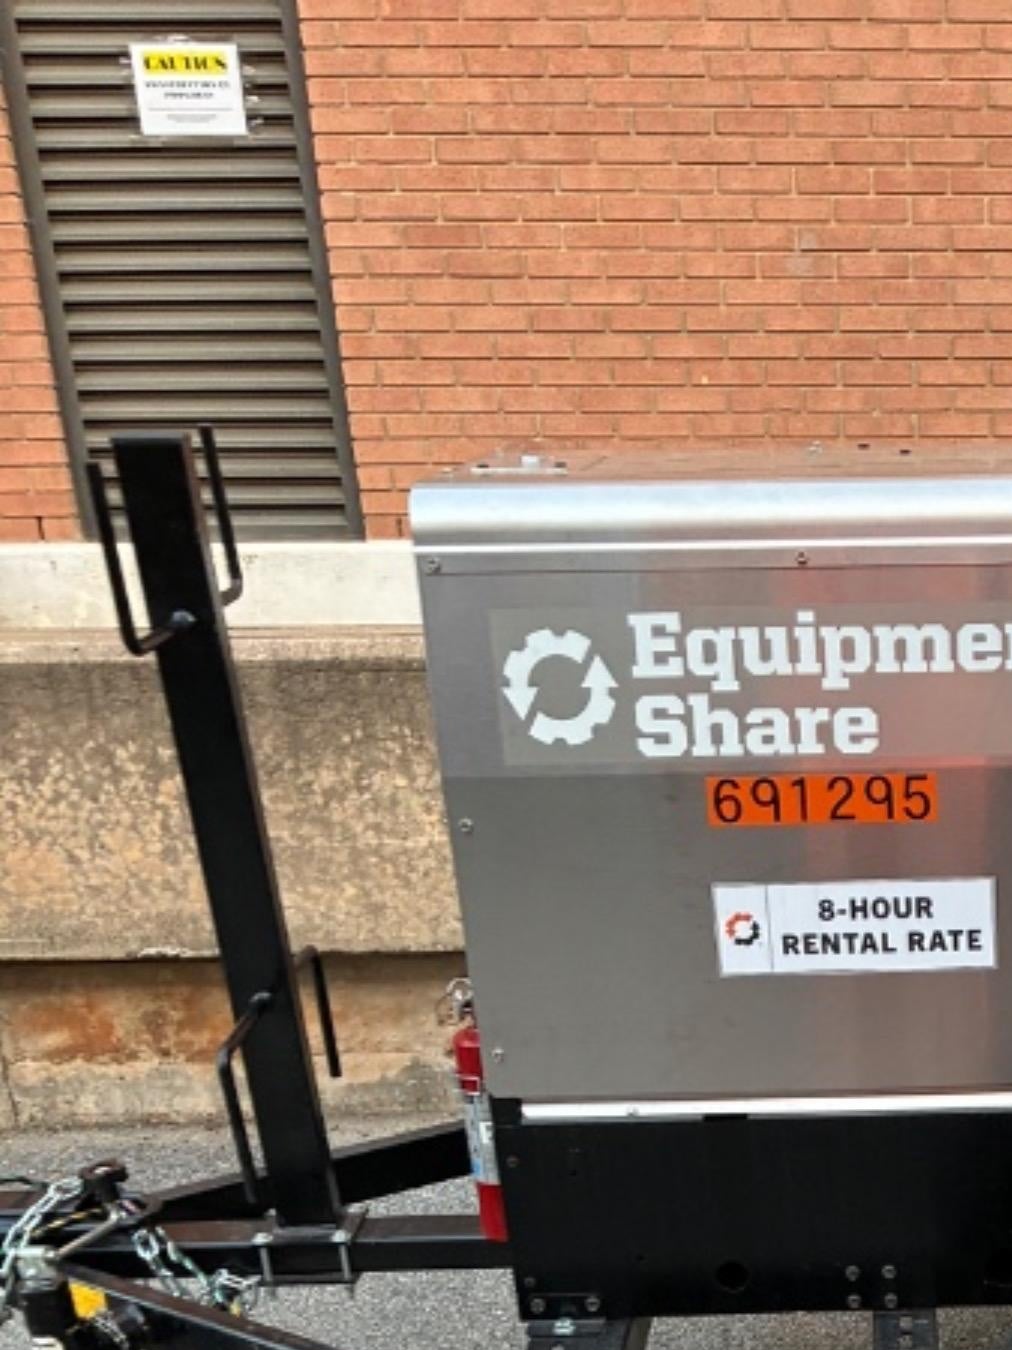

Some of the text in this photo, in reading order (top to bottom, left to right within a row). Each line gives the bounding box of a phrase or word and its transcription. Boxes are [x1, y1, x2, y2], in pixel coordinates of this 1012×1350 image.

[635, 693, 880, 757] Share
[713, 775, 931, 823] 691295
[818, 896, 933, 922] 8-HOUR
[781, 928, 983, 956] RENTAL RATE
